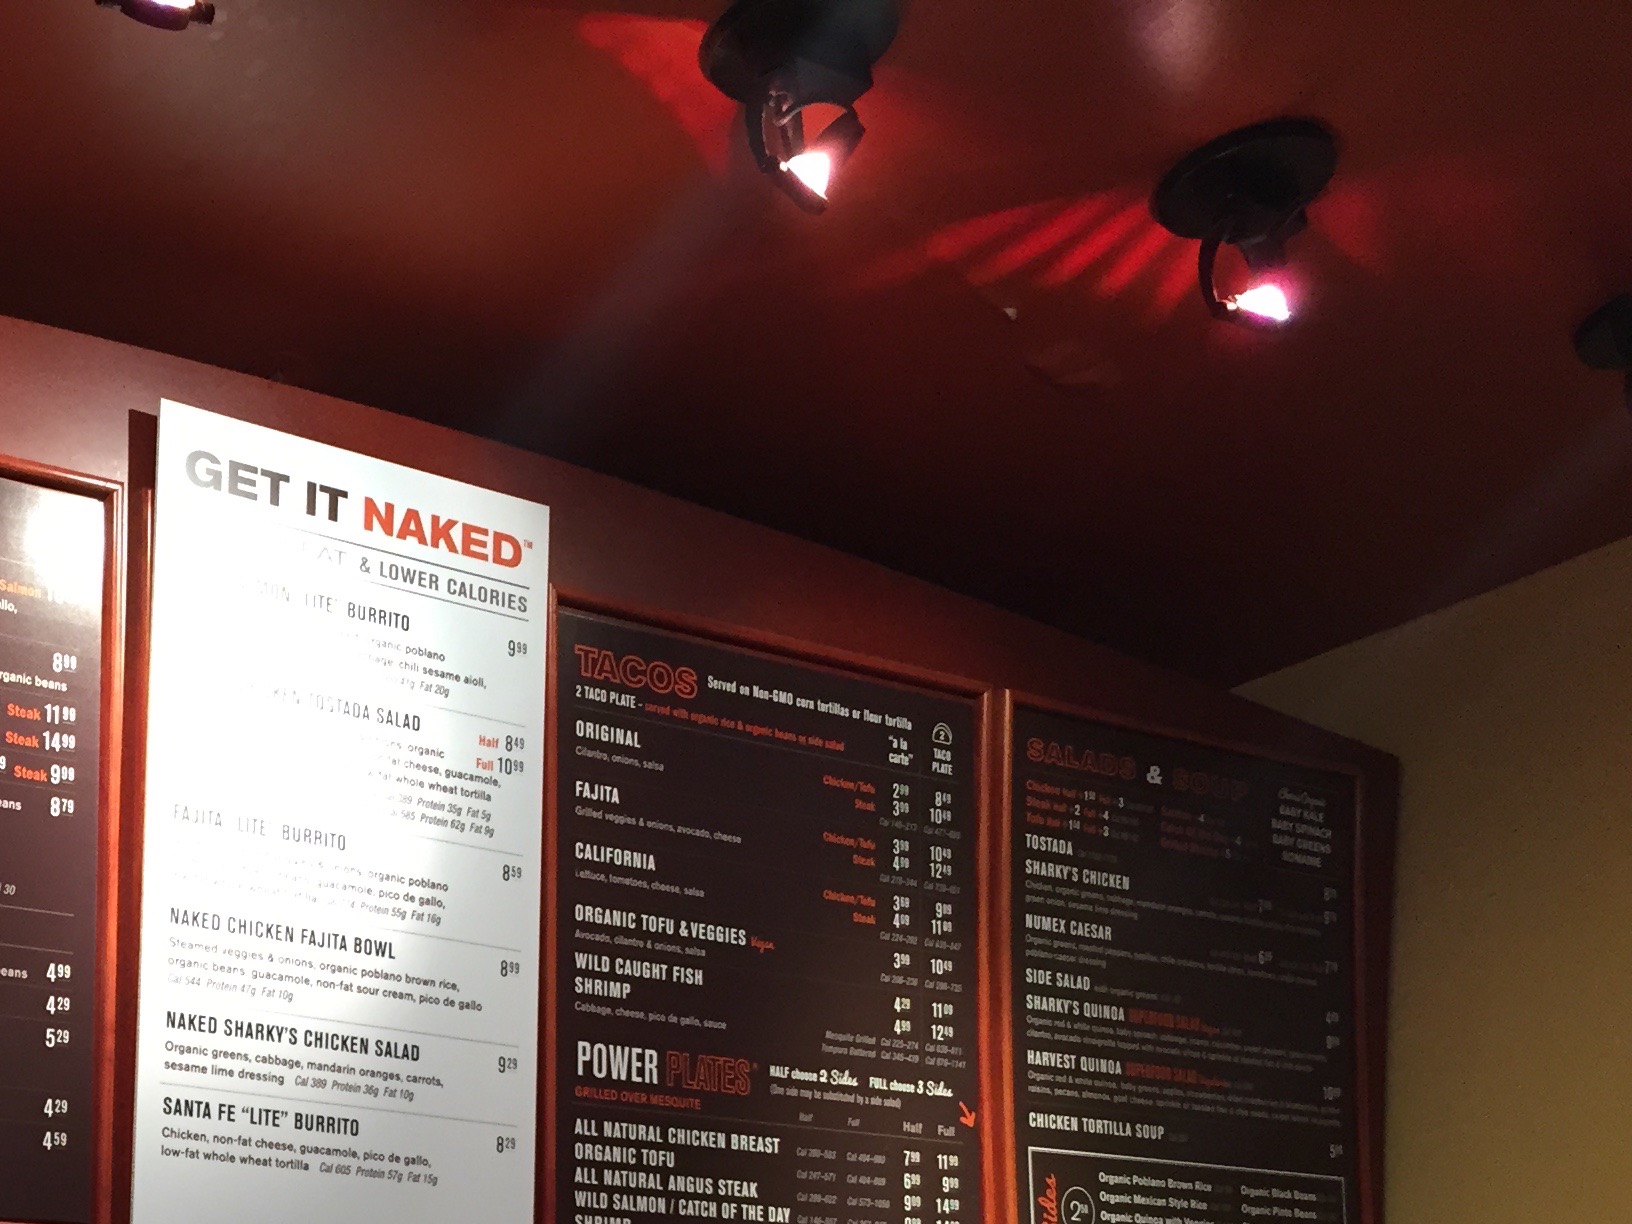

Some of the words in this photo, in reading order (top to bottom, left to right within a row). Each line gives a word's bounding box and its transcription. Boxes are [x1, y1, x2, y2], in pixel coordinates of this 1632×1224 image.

[186, 450, 290, 506] GET
[306, 481, 348, 522] IT
[364, 496, 523, 569] NAKED
[380, 561, 439, 591] LOWER
[447, 579, 528, 613] CALORIES
[575, 645, 698, 698] TACOS
[377, 708, 420, 732] SALAD
[575, 720, 641, 748] ORIGINAL
[1026, 737, 1136, 781] SALADS
[1146, 765, 1162, 785] &
[575, 781, 620, 804] FAJITA
[575, 842, 656, 871] CALIFORNIA
[1025, 834, 1073, 856] TOSTADA
[1025, 859, 1079, 882] SHARKY'S
[1083, 869, 1130, 891] CHICKEN
[170, 908, 221, 931] NAKED
[228, 917, 294, 943] CHICKEN
[301, 929, 347, 952] FAJITA
[354, 937, 396, 960] BOWL
[575, 904, 637, 929] ORGANIC
[641, 914, 675, 934] TOFU
[690, 921, 747, 947] VEGGIES
[1025, 914, 1066, 934] NUMEX
[1070, 920, 1112, 941] CAESAR
[575, 952, 610, 974] WILD
[614, 957, 668, 981] CAUGHT
[672, 966, 704, 986] FISH
[1025, 968, 1052, 986] SIDE
[1056, 972, 1090, 991] SALAD
[575, 977, 632, 1000] SHRIMP
[166, 1011, 217, 1034] NAKED
[224, 1019, 298, 1045] SHARKY'S
[304, 1030, 369, 1055] CHICKEN
[374, 1039, 420, 1062] SALAD
[165, 1041, 208, 1057] Organic
[211, 1048, 252, 1064] greens,
[255, 1052, 304, 1070] cabbage,
[307, 1060, 356, 1075] mandarin
[359, 1068, 404, 1083] oranges,
[406, 1074, 444, 1088] carrots,
[577, 1040, 659, 1085] POWER
[666, 1050, 751, 1095] PLATES
[1027, 1049, 1076, 1069] HARVEST
[1080, 1056, 1122, 1075] QUINOA
[163, 1097, 212, 1120] SANTA
[218, 1102, 236, 1122] FE
[294, 1113, 359, 1136] BURRITO
[1028, 1112, 1078, 1131] CHICKEN
[1082, 1117, 1132, 1137] TORTILLA
[1136, 1122, 1164, 1140] SOUP
[575, 1118, 598, 1137] ALL
[603, 1121, 663, 1142] NATURAL
[668, 1128, 728, 1149] CHICKEN
[731, 1134, 780, 1154] BREAST
